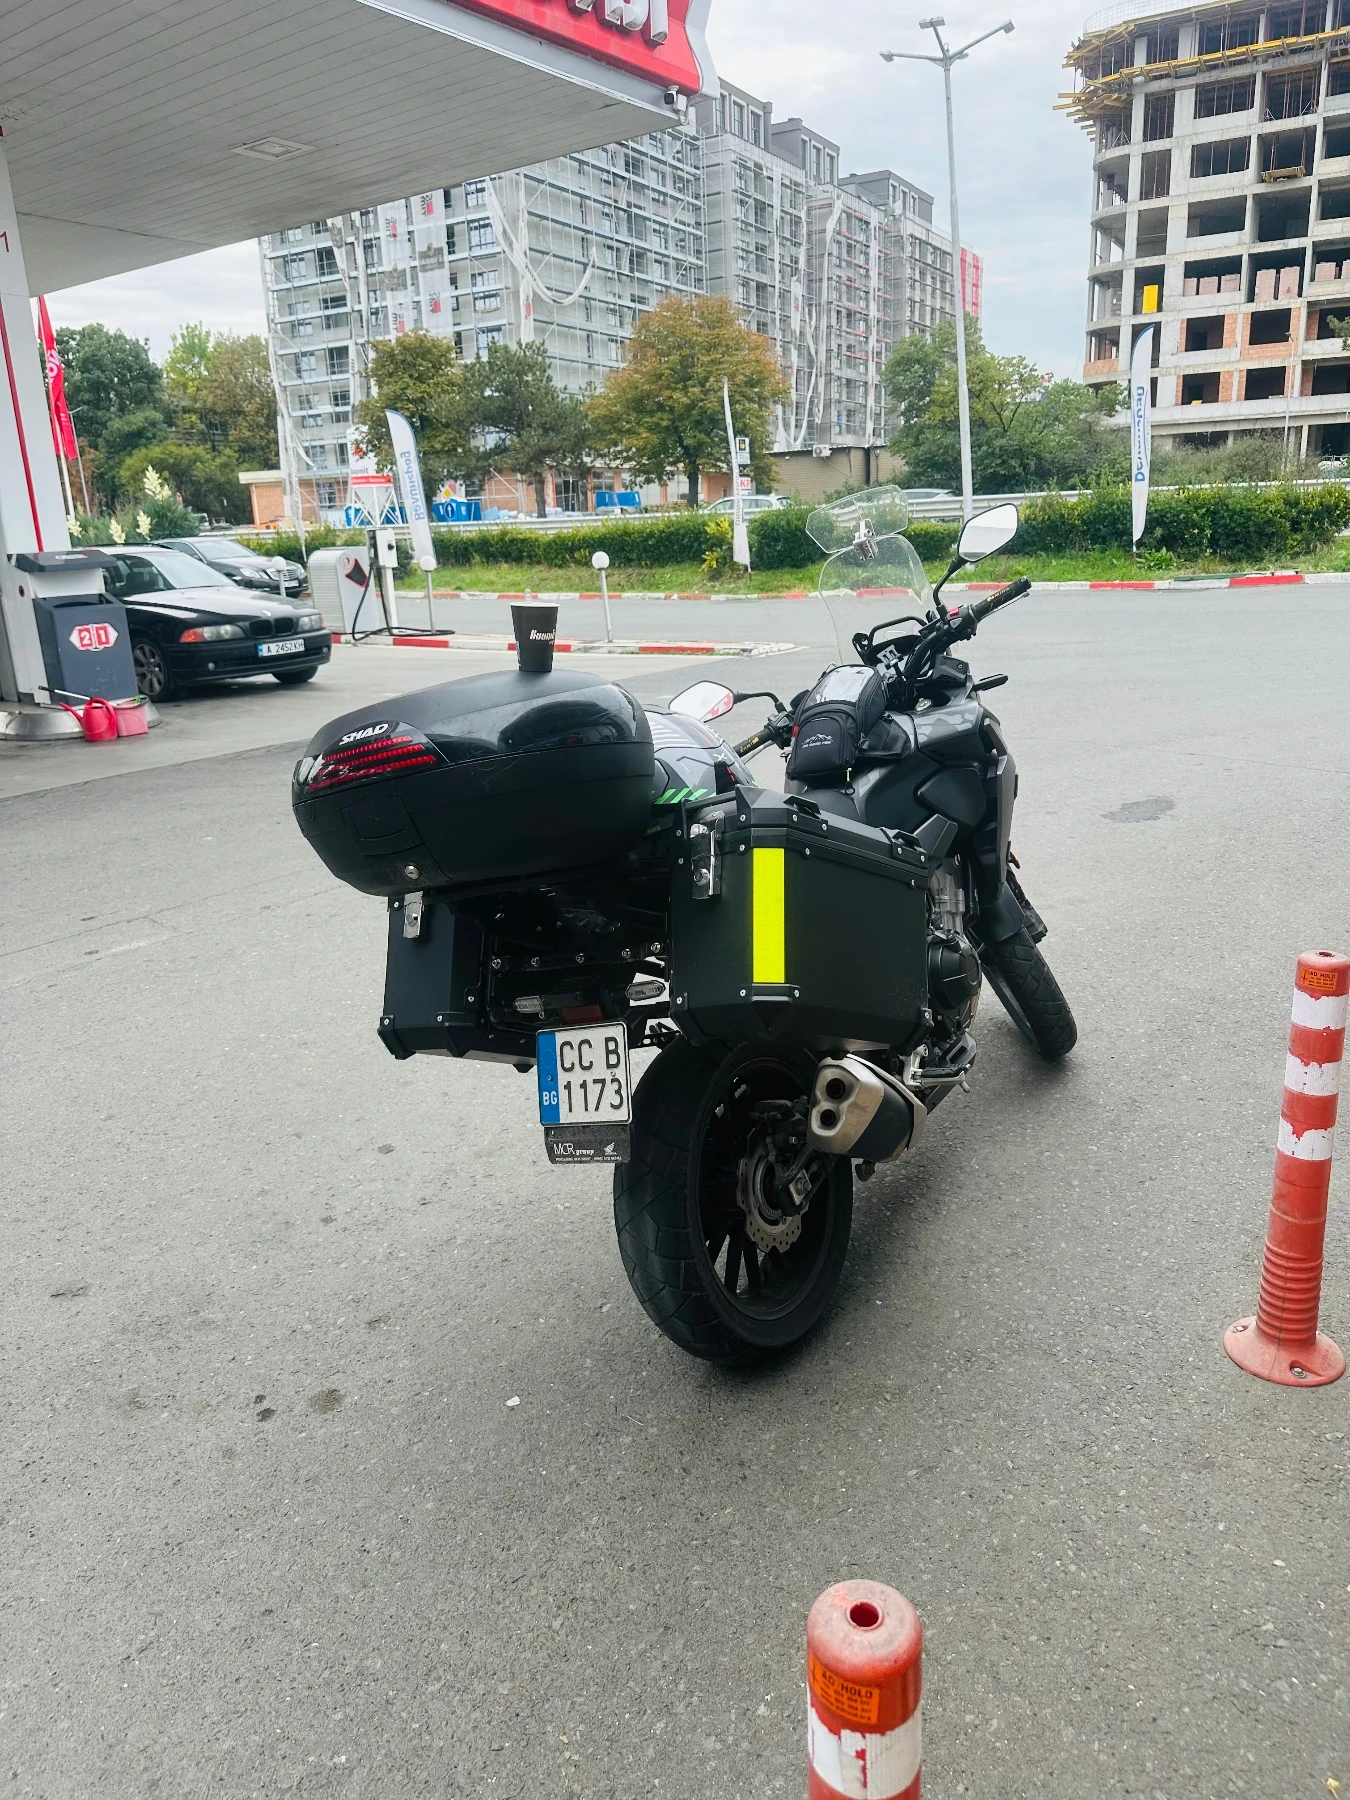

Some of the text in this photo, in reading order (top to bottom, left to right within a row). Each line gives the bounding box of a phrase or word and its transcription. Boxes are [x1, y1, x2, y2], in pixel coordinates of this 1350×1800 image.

[267, 645, 273, 654] A
[339, 723, 389, 746] SHAD
[559, 1036, 621, 1072] CC B
[542, 1091, 558, 1106] BG
[563, 1077, 624, 1112] 1173
[553, 1142, 575, 1155] MCR
[821, 1669, 873, 1699] AD HOLD
